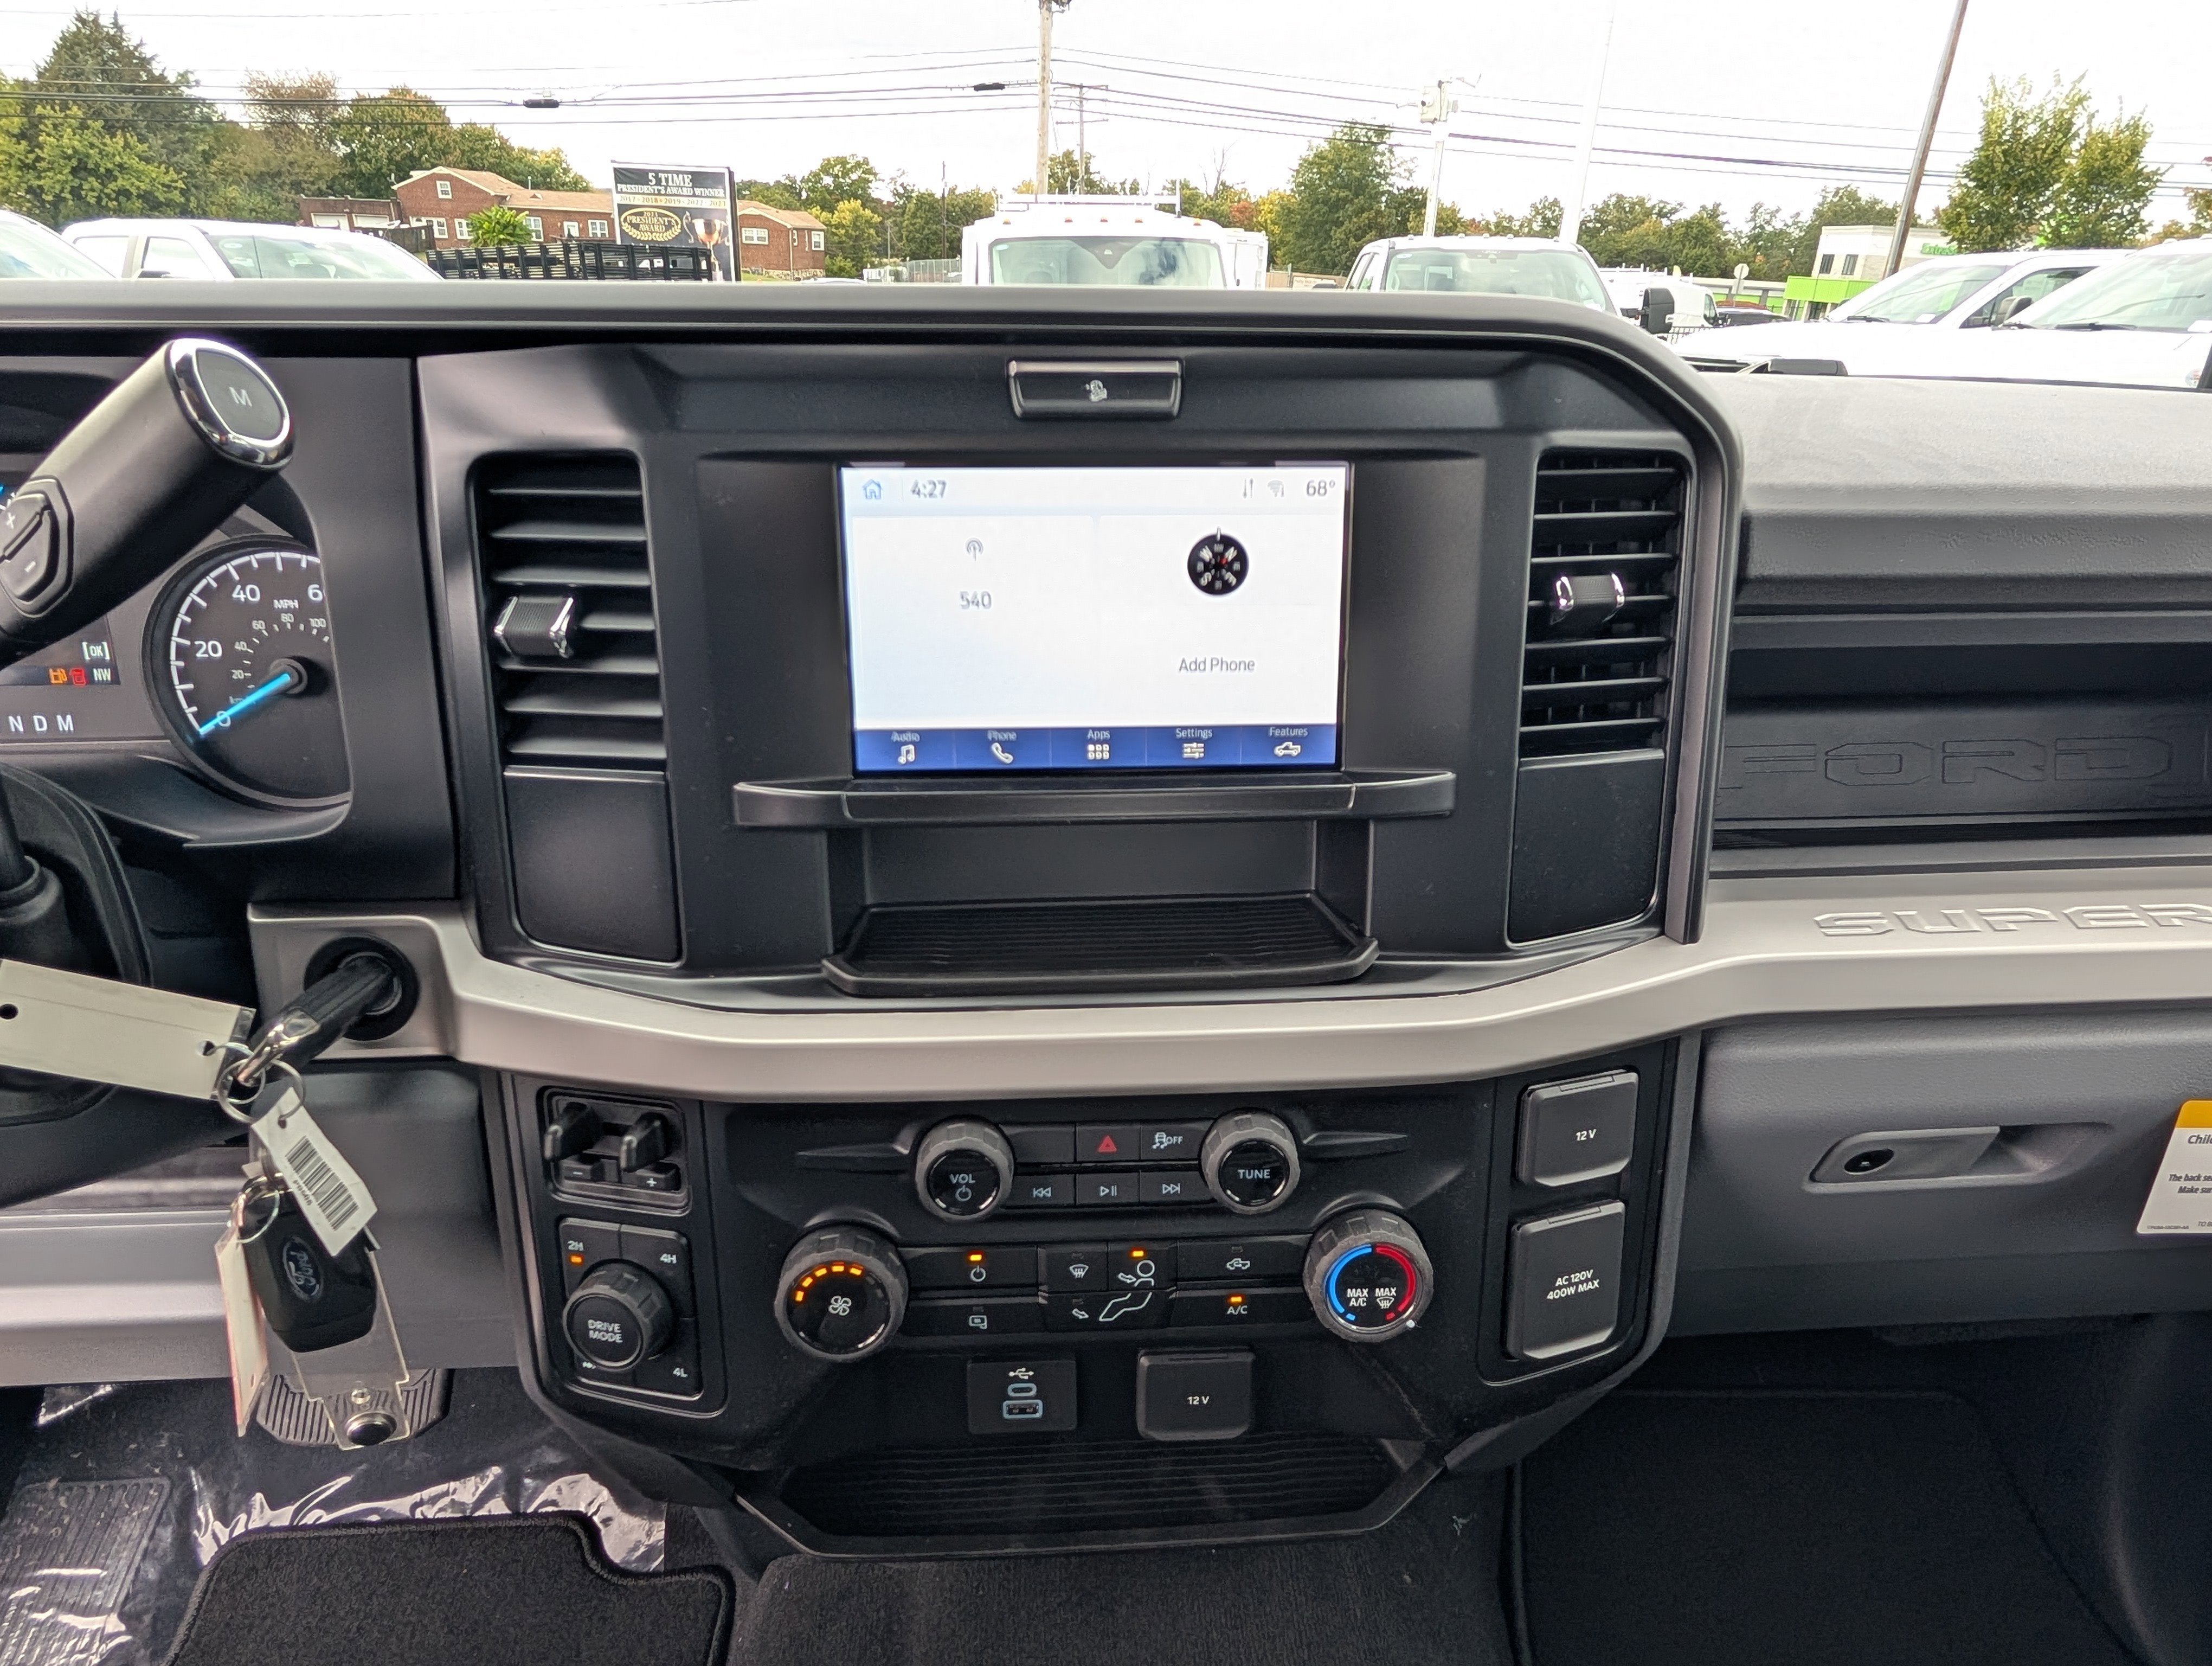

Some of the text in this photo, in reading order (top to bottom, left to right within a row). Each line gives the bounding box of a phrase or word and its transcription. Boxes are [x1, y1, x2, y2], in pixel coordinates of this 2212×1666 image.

[648, 172, 692, 187] 5 TIME
[617, 183, 725, 197] PRESIDENT'S AWARD WINNER
[626, 215, 676, 226] PRESIDENT'S
[638, 223, 666, 232] AWARD
[229, 386, 253, 407] M
[910, 479, 948, 499] 4:27
[1306, 479, 1336, 497] 68°
[232, 585, 261, 602] 40
[307, 584, 324, 602] 6
[273, 599, 299, 609] MPH
[959, 591, 993, 610] 540
[252, 620, 266, 630] 60
[309, 618, 326, 628] 100
[196, 640, 222, 658] 20
[234, 641, 247, 651] 40
[1179, 657, 1256, 672] Add Phone
[93, 668, 111, 681] NW
[231, 669, 244, 679] 20
[8, 714, 74, 732] N D M
[891, 731, 921, 742] Audio
[987, 730, 1018, 742] Phone
[1087, 729, 1110, 741] Apps
[1175, 727, 1213, 740] Settings
[1269, 727, 1308, 738] Features
[1720, 736, 2172, 790] FORD
[1813, 903, 2212, 937] SUPER
[1167, 1136, 1183, 1145] OFF
[1576, 1129, 1597, 1141] 12 V
[950, 1174, 976, 1184] VOL
[1238, 1168, 1271, 1180] TUNE
[568, 1240, 584, 1251] 2H
[660, 1253, 677, 1264] 4H
[1555, 1270, 1593, 1286] AC 120V
[1347, 1288, 1368, 1298] MAX
[1375, 1287, 1397, 1297] MAX
[1546, 1279, 1599, 1300] 400W MAX
[1349, 1298, 1367, 1307] A/C
[1227, 1305, 1248, 1315] A/C
[588, 1319, 622, 1333] DRIVE
[589, 1330, 623, 1343] MODE
[673, 1367, 689, 1378] 4L
[1187, 1396, 1210, 1405] 12 V
